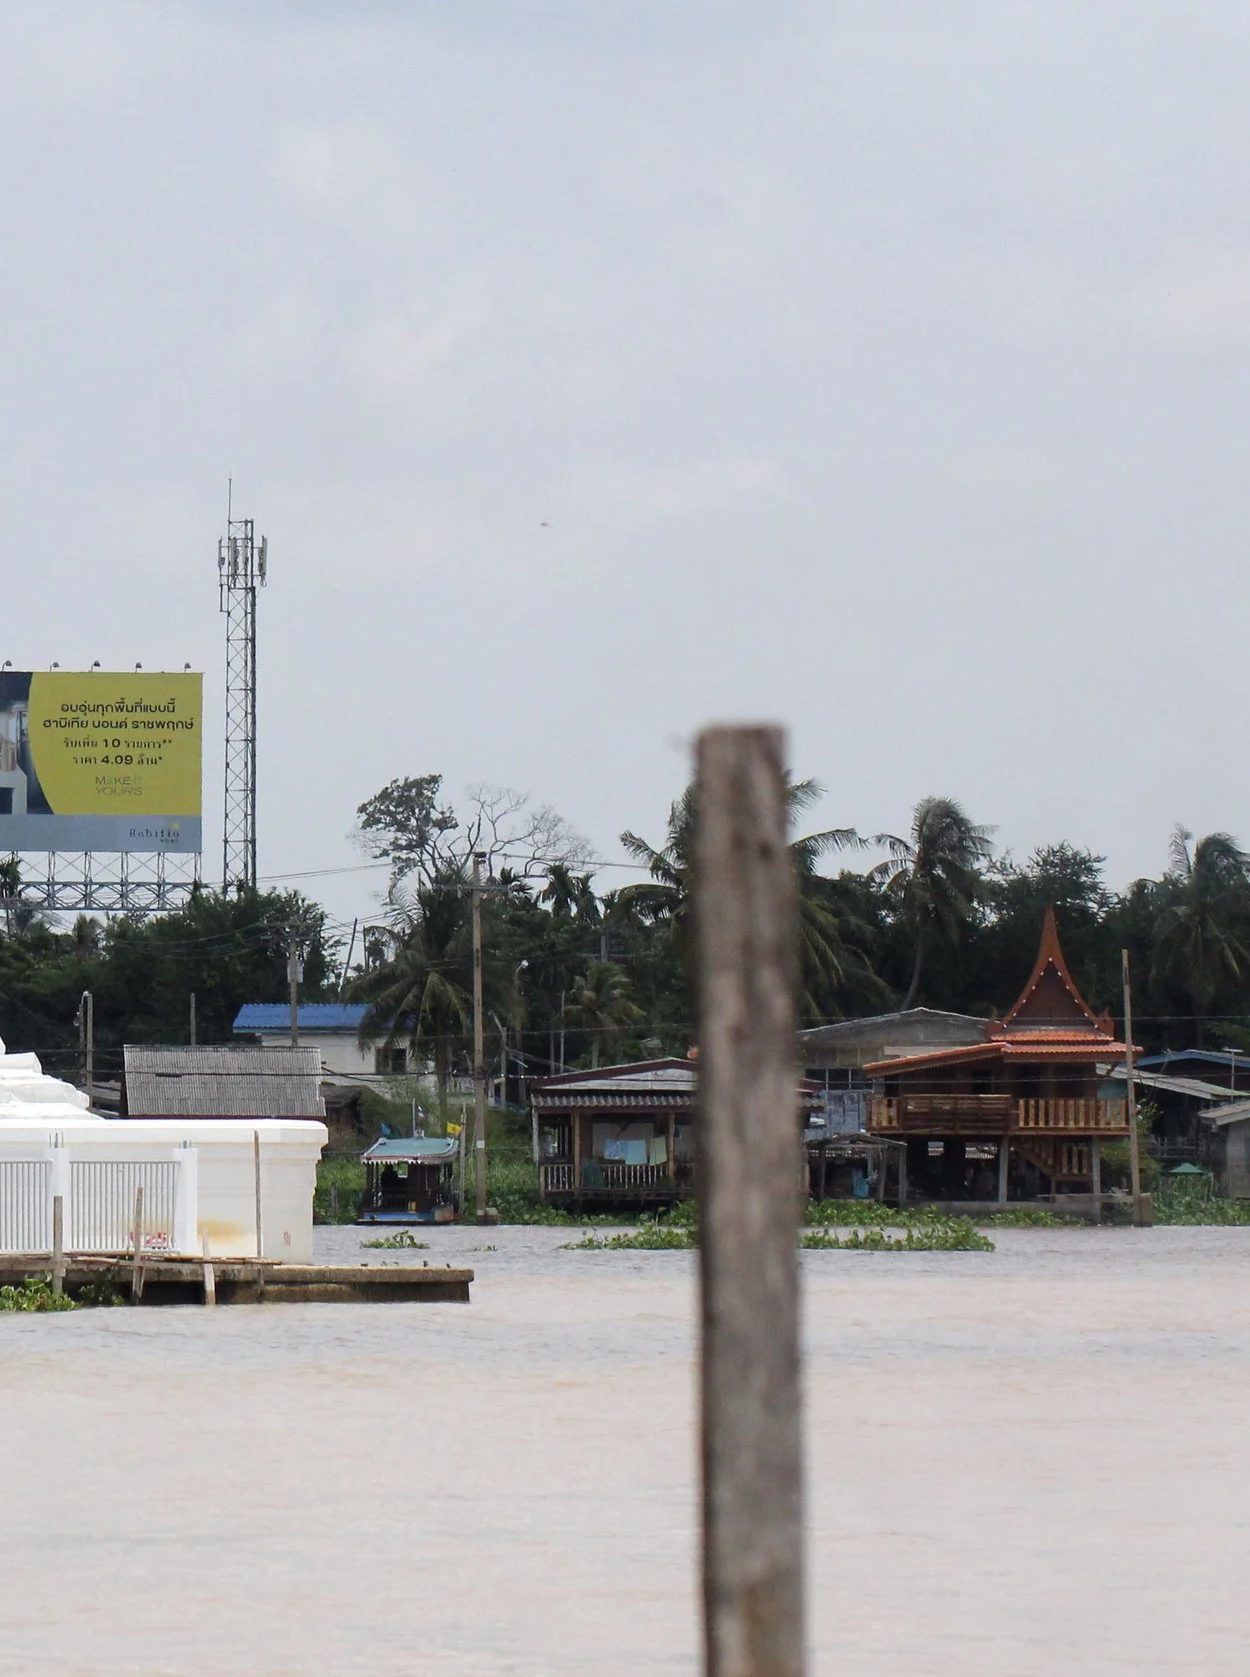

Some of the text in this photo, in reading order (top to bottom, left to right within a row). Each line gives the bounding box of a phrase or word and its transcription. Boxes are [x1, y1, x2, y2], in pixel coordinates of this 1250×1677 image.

[61, 698, 176, 717] อบอุ่นทุกพื้นที่แบบนี้
[93, 717, 128, 729] บอนด์
[132, 717, 194, 732] ราชพฤกษ์
[103, 738, 121, 749] 10
[101, 755, 134, 765] 4.09
[96, 786, 143, 796] YOURS
